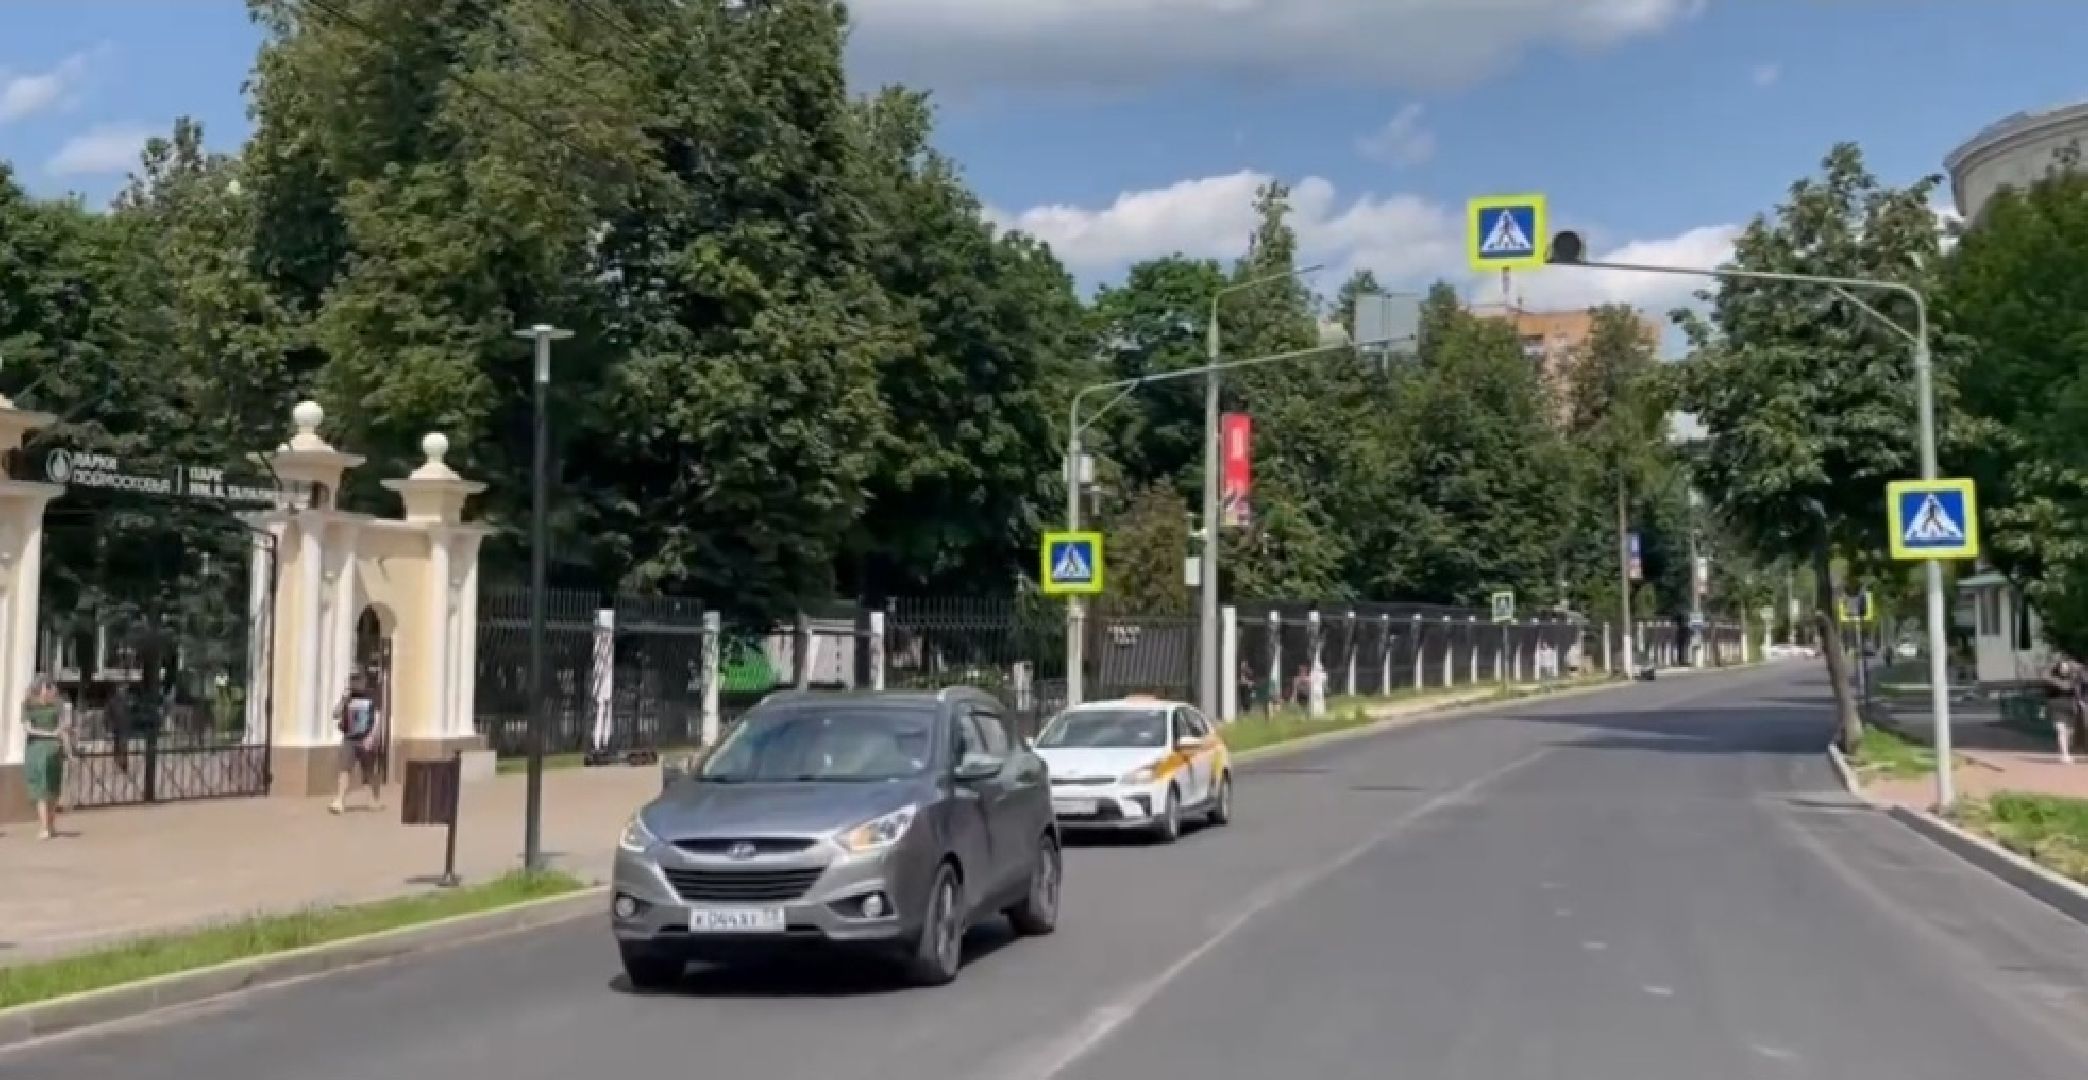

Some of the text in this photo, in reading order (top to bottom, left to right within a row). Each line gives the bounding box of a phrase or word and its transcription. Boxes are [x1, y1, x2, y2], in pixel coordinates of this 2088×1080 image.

[73, 452, 117, 470] ПАРКИ
[73, 469, 171, 494] ПОДМОСКОВЬЯ
[188, 466, 223, 481] ПАРК
